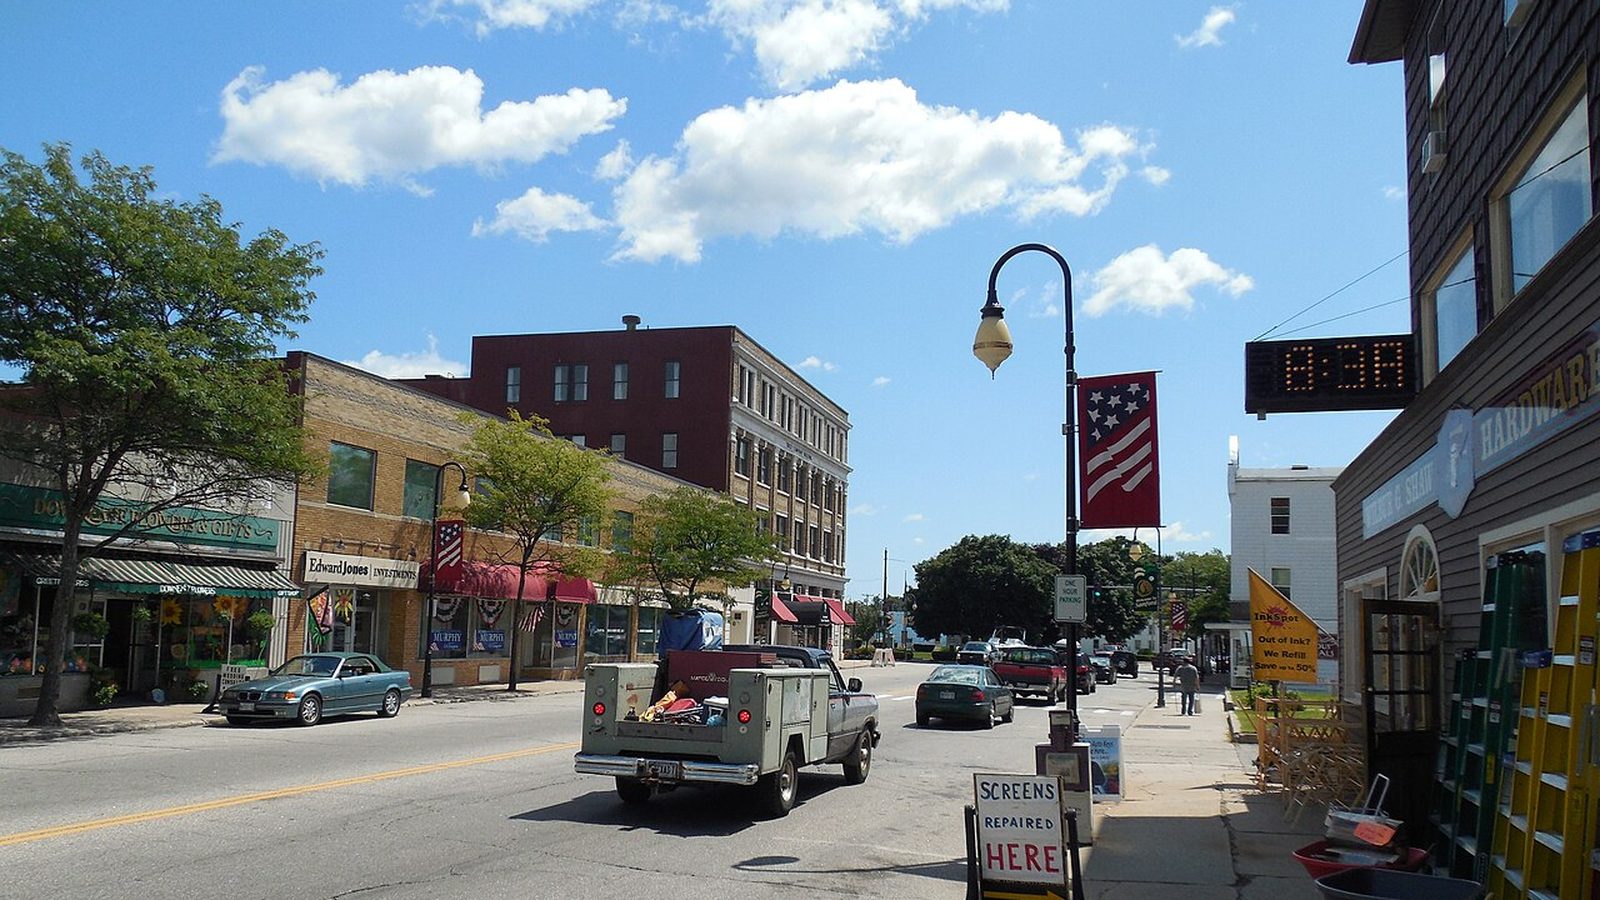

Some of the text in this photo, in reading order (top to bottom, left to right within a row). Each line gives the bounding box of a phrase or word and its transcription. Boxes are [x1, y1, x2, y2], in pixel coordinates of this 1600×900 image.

[1481, 339, 1600, 461] HARDWARE
[211, 520, 252, 538] GIFTS
[373, 567, 417, 580] INVESTMENTS
[1254, 613, 1298, 622] InkSpot
[433, 633, 462, 642] MURPHY
[1289, 637, 1311, 645] Ink?
[1263, 650, 1307, 659] We Refill
[1254, 662, 1278, 670] Save
[1296, 663, 1316, 673] 50%
[980, 782, 1055, 800] SCREENS
[985, 817, 1054, 829] REPAIRED
[986, 843, 1060, 873] HERE
